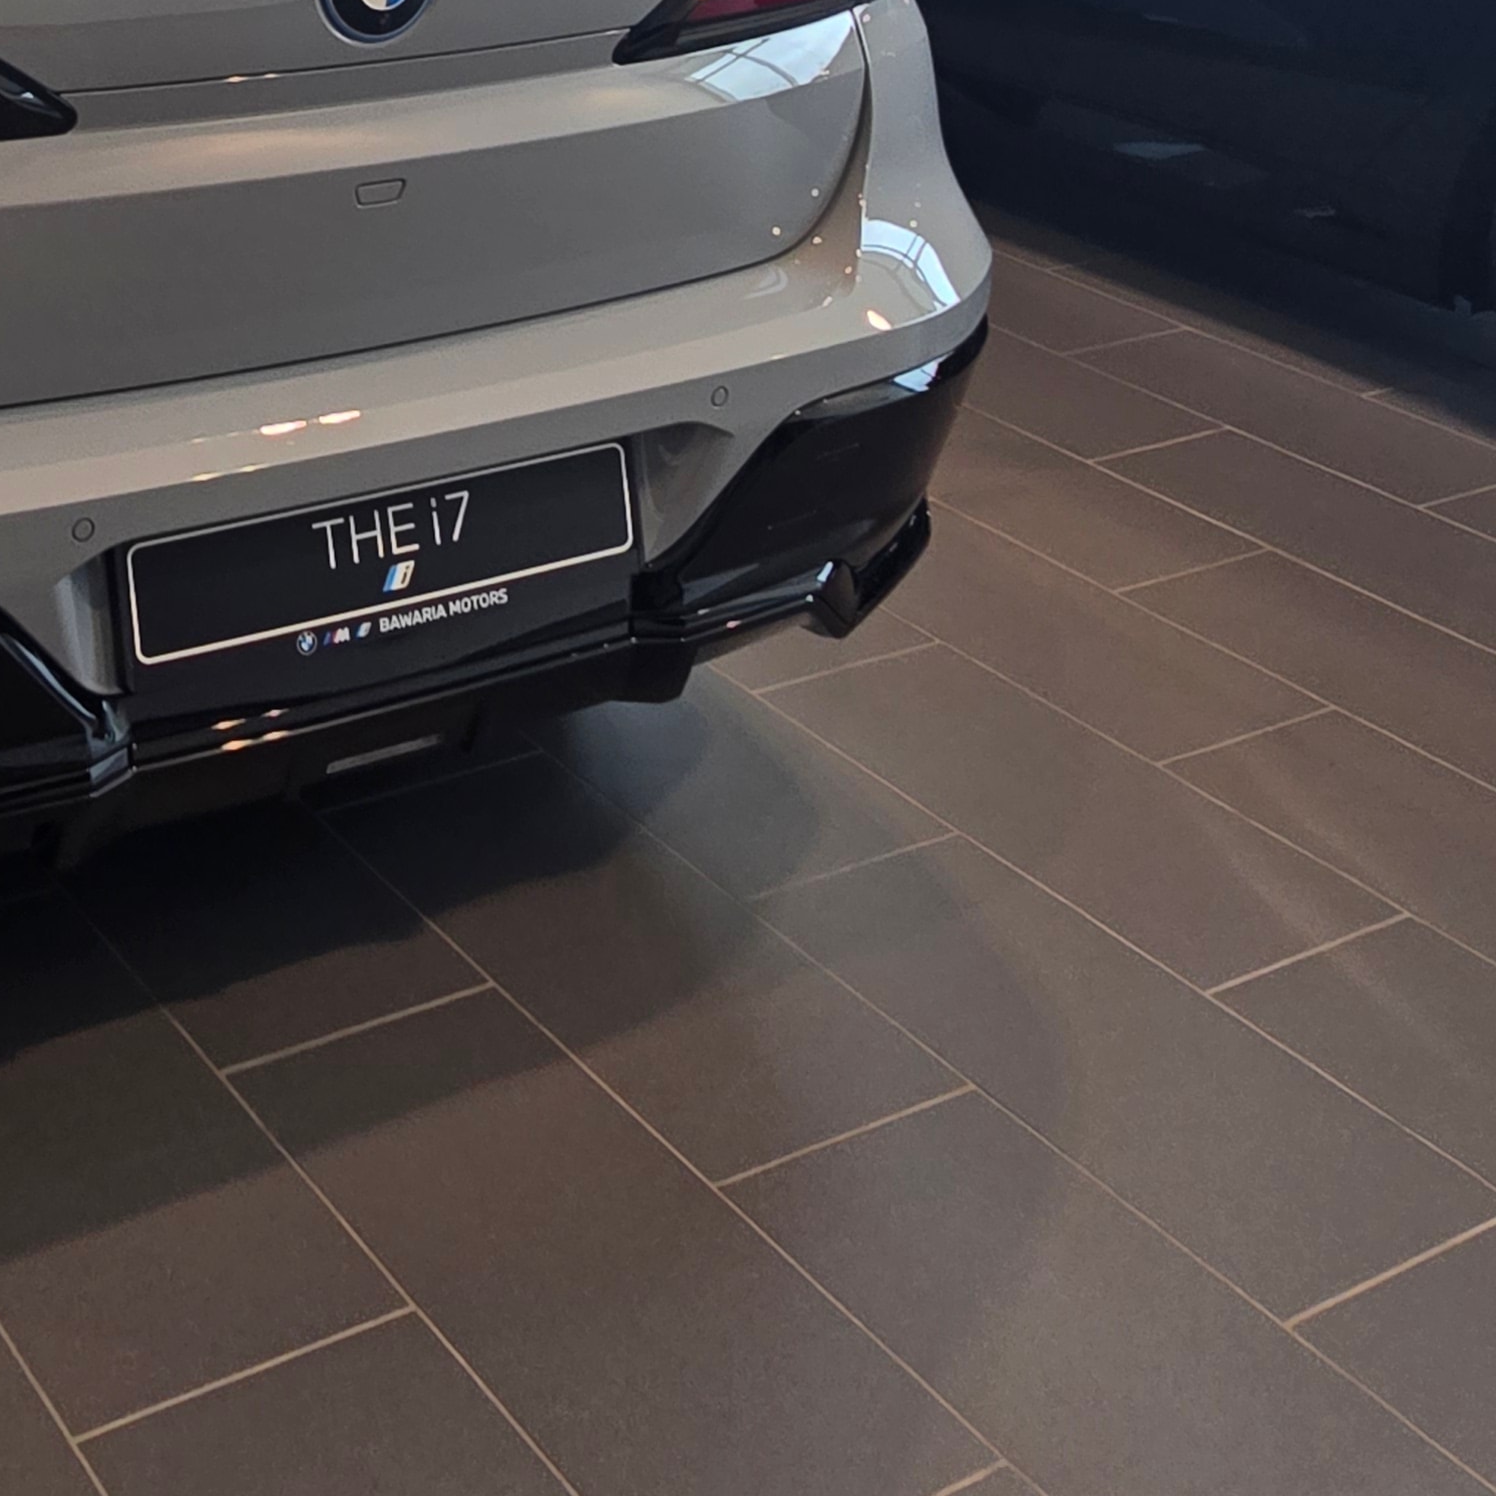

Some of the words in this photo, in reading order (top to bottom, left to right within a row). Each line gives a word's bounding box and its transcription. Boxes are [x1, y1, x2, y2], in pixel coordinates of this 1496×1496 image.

[311, 502, 420, 570] THE
[430, 490, 470, 546] i7
[378, 603, 447, 633] BAWARIA
[448, 588, 509, 616] MOTORS
